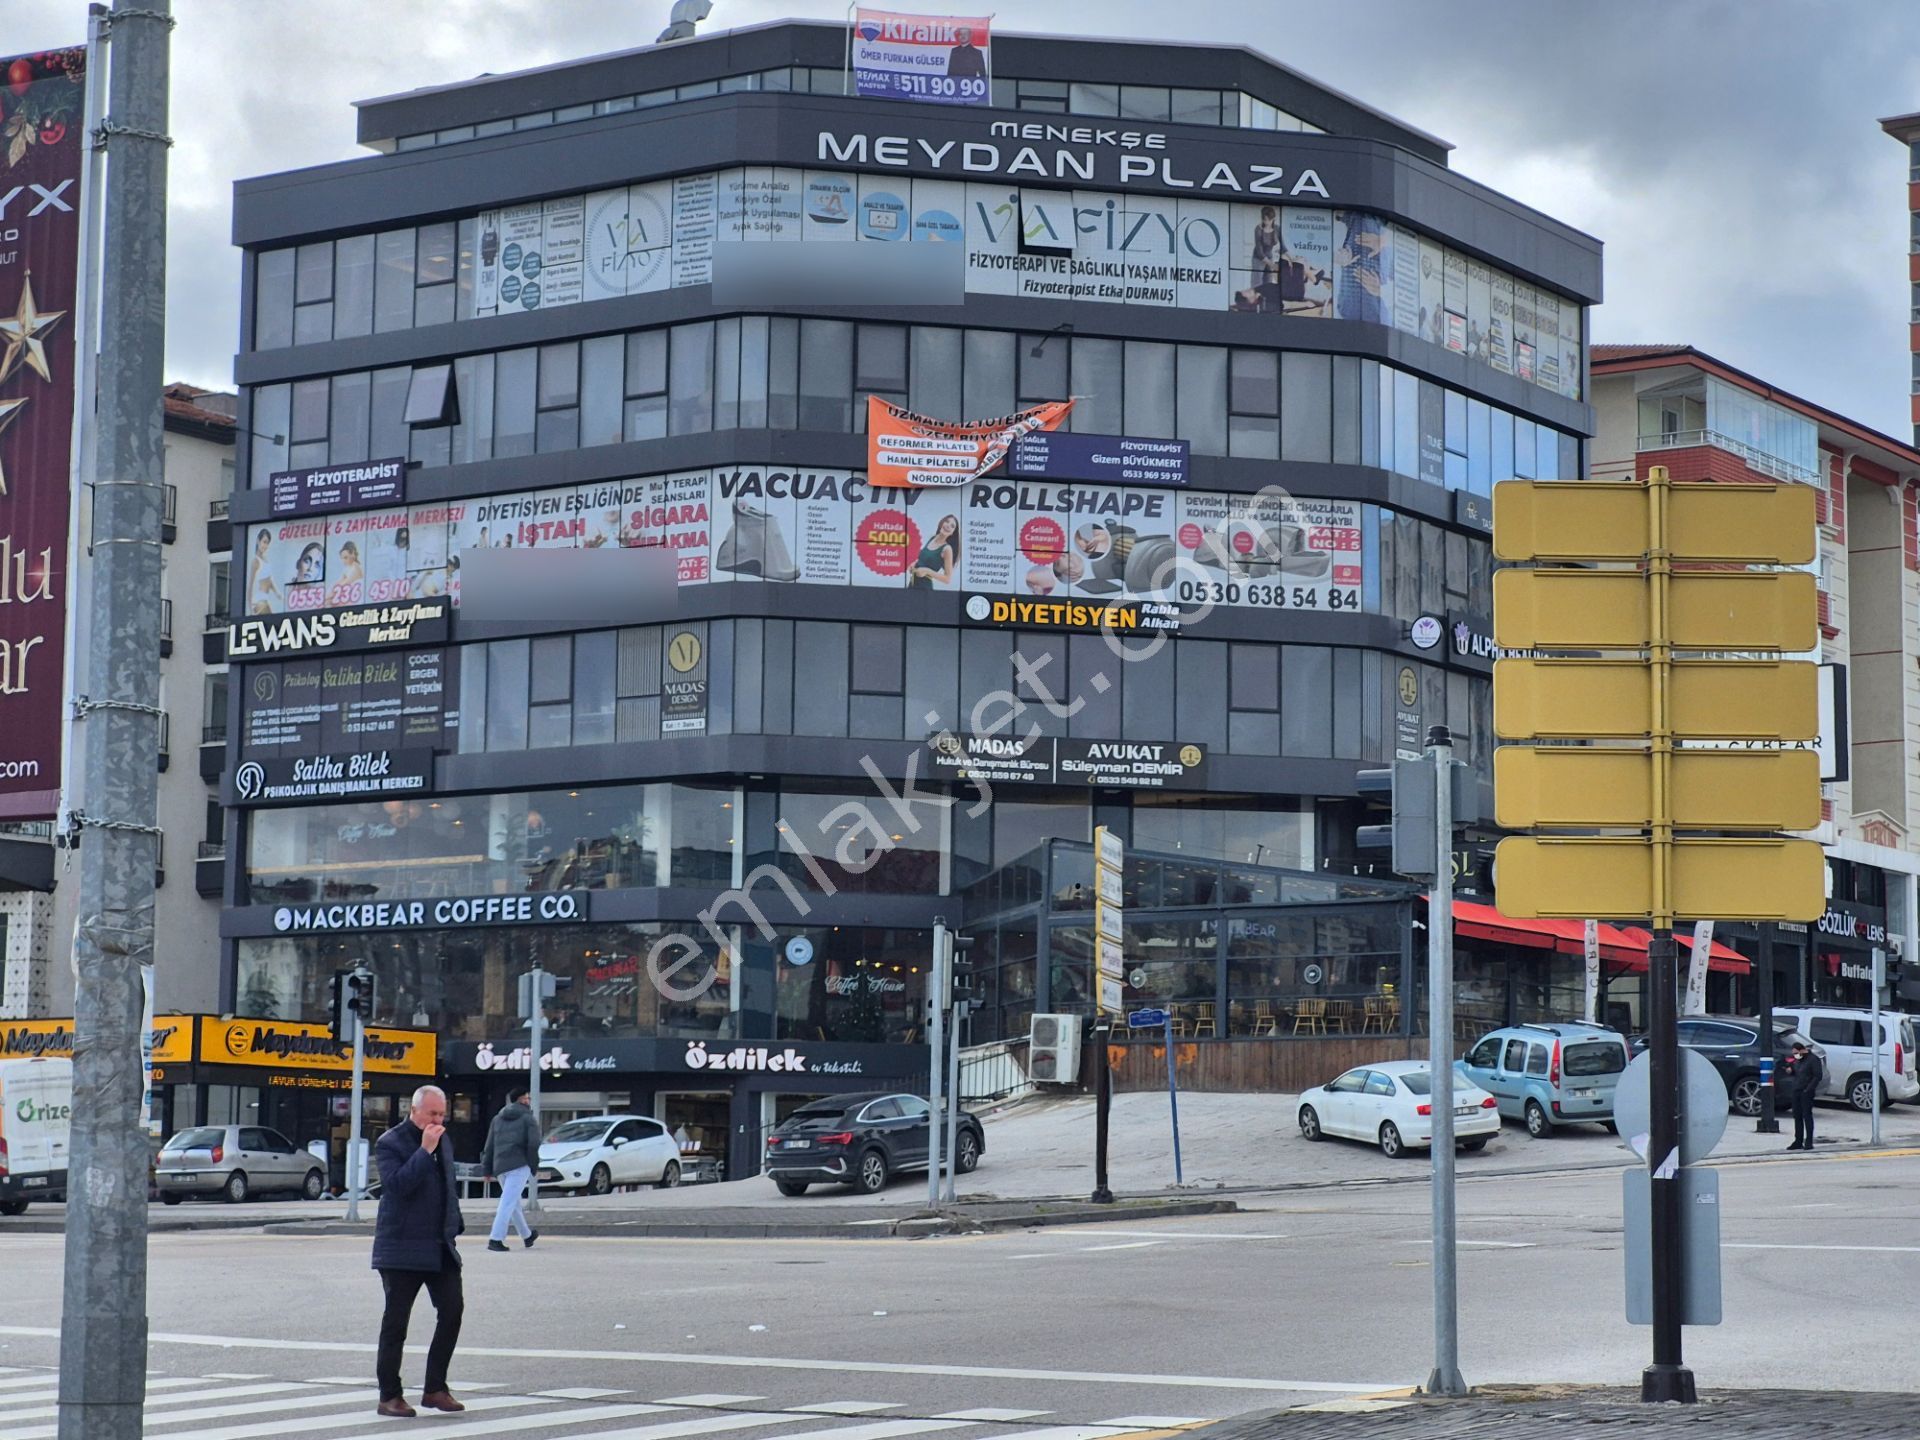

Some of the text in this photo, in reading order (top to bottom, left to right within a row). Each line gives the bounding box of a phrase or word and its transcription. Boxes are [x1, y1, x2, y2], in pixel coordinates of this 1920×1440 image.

[861, 48, 945, 67] ÖMER FURKAN GÜLSER
[857, 71, 890, 82] RE/MAX
[901, 75, 926, 93] 511
[931, 77, 955, 95] 90
[960, 78, 985, 96] 90
[991, 121, 1166, 150] MENEKŞE
[818, 132, 1330, 198] MEYDAN PLAZA
[1293, 241, 1328, 253] viafizyo
[970, 250, 1222, 285] FİZYOTERAPİ VE SAĞLIKLI YAŞAM MERKEZİ
[1024, 279, 1174, 302] Fizyoterapist Etka DURMUŞ
[880, 438, 933, 449] REFORMER
[1121, 441, 1182, 453] FİZYOTERAPİST
[887, 454, 970, 468] HAMİLE PİLATESİ
[1123, 455, 1181, 468] BÜYÜKMERT
[307, 462, 399, 487] FİZYOTERAPİST
[673, 476, 707, 488] TERAPİ
[1123, 470, 1142, 478] 0533
[1144, 471, 1158, 479] 969
[477, 486, 643, 522] DİYETİSYEN EŞLİĞİNDE
[651, 490, 705, 504] SEANSLARI
[970, 485, 1165, 518] ROLLSHAPE
[1186, 496, 1222, 507] DEVRİM
[335, 505, 466, 534] & ZAYIFLAMA MERKEZİ
[631, 503, 709, 529] SİGARA
[518, 518, 586, 547] İŞTAH
[874, 522, 903, 530] Haftada
[868, 531, 909, 547] 5000
[1350, 530, 1360, 539] 2
[876, 549, 898, 557] Kalori
[1350, 541, 1360, 550] 5
[701, 558, 707, 566] 2
[701, 569, 707, 577] 5
[288, 588, 324, 608] 0553
[333, 584, 361, 602] 236
[1179, 581, 1358, 610] 0530 638 54 84
[993, 598, 1179, 628] DİYETİSYEN Rabia
[229, 614, 336, 655] LEWANS
[339, 609, 379, 627] Güzellik
[381, 608, 389, 623] &
[1140, 617, 1179, 630] Alkan
[368, 625, 410, 643] Merkezi
[408, 654, 440, 667] ÇOCUK
[323, 665, 362, 688] Saliha
[364, 662, 397, 683] Bilek
[410, 668, 438, 679] ERGEN
[665, 681, 705, 695] MADAS
[672, 694, 698, 704] DESIGN
[968, 738, 1024, 756] MADAS
[1088, 744, 1164, 760] AVUKAT
[293, 750, 390, 782] Saliha Bilek
[936, 756, 961, 766] Hukuk
[973, 758, 1019, 770] Danışmanlık
[1020, 760, 1049, 770] Bürosu
[1062, 760, 1183, 775] Süleyman DEMİR
[318, 779, 380, 796] DANIŞMANLIK
[293, 894, 579, 930] MACKBEAR COFFEE CO.
[1818, 907, 1885, 942] GÖZLÜK LENS
[825, 973, 905, 995] Coffee House
[574, 1060, 584, 1071] ev
[585, 1055, 617, 1070] tekstili
[685, 1040, 863, 1074] Özdilek ev tekstili
